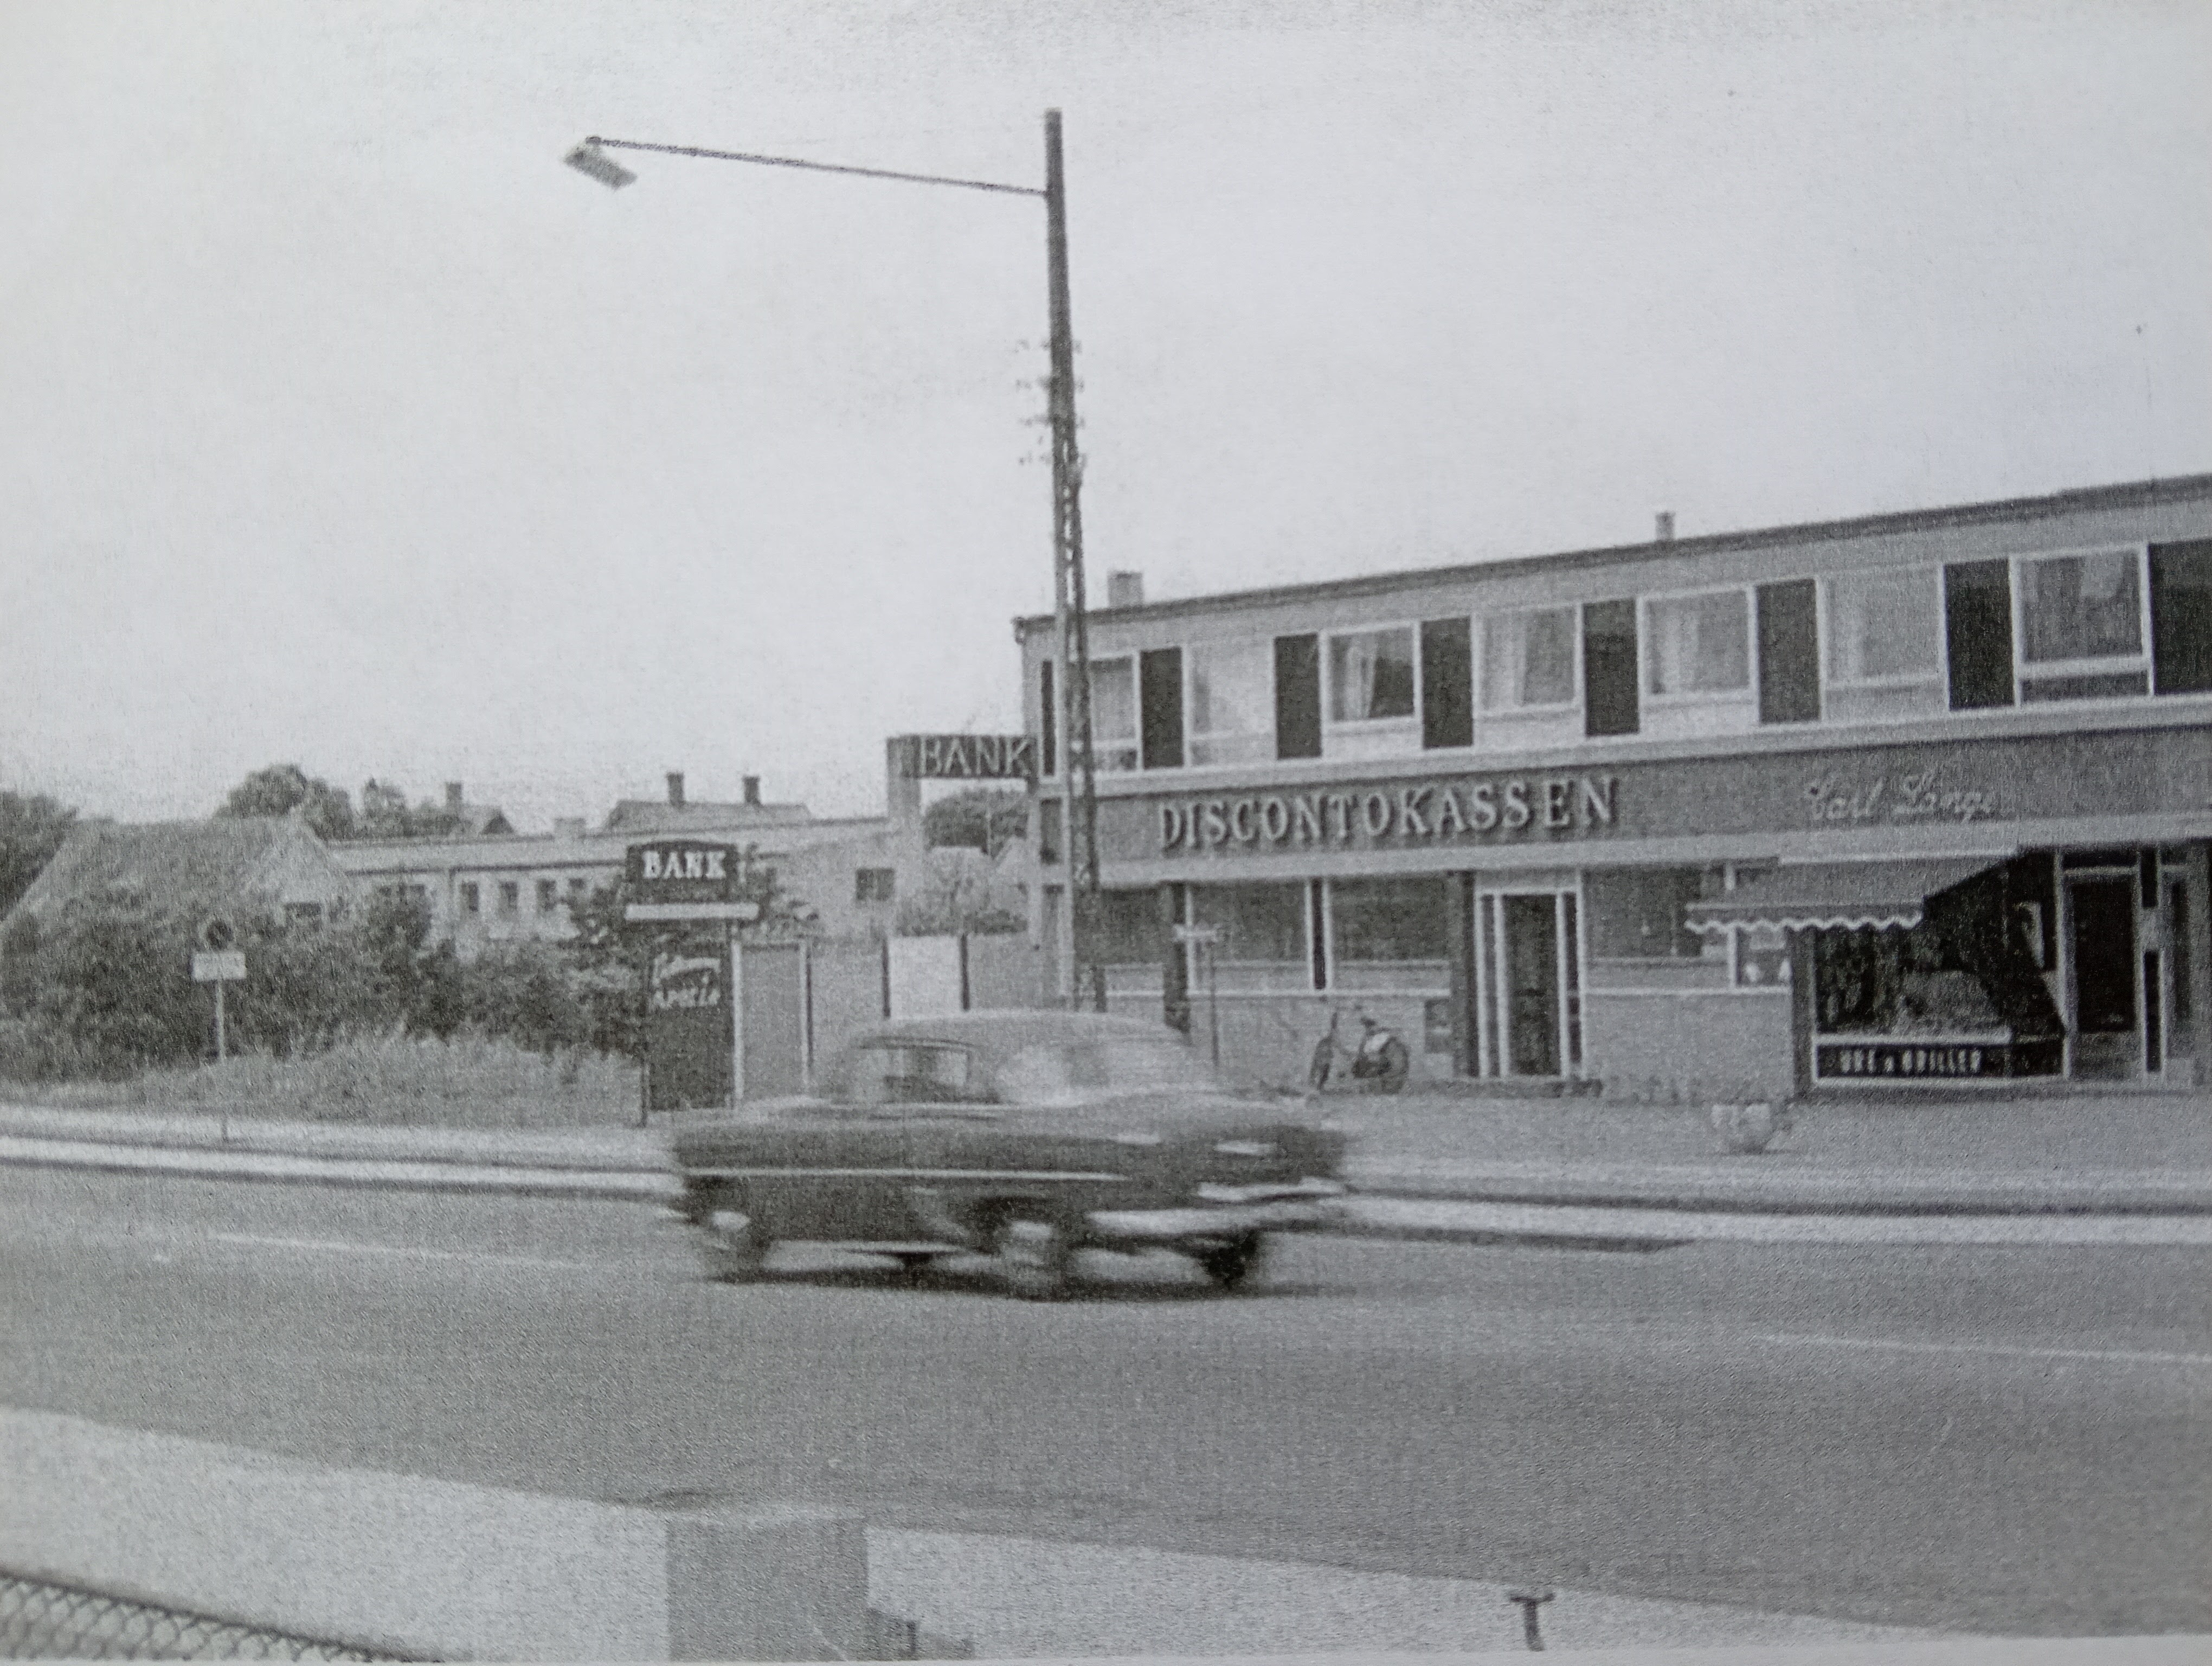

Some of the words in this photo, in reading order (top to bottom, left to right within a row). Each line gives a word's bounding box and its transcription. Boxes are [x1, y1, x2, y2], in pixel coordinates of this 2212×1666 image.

[919, 736, 1031, 776] BANK
[1158, 776, 1618, 850] DISCONTOKASSEN
[642, 850, 727, 880] BANK
